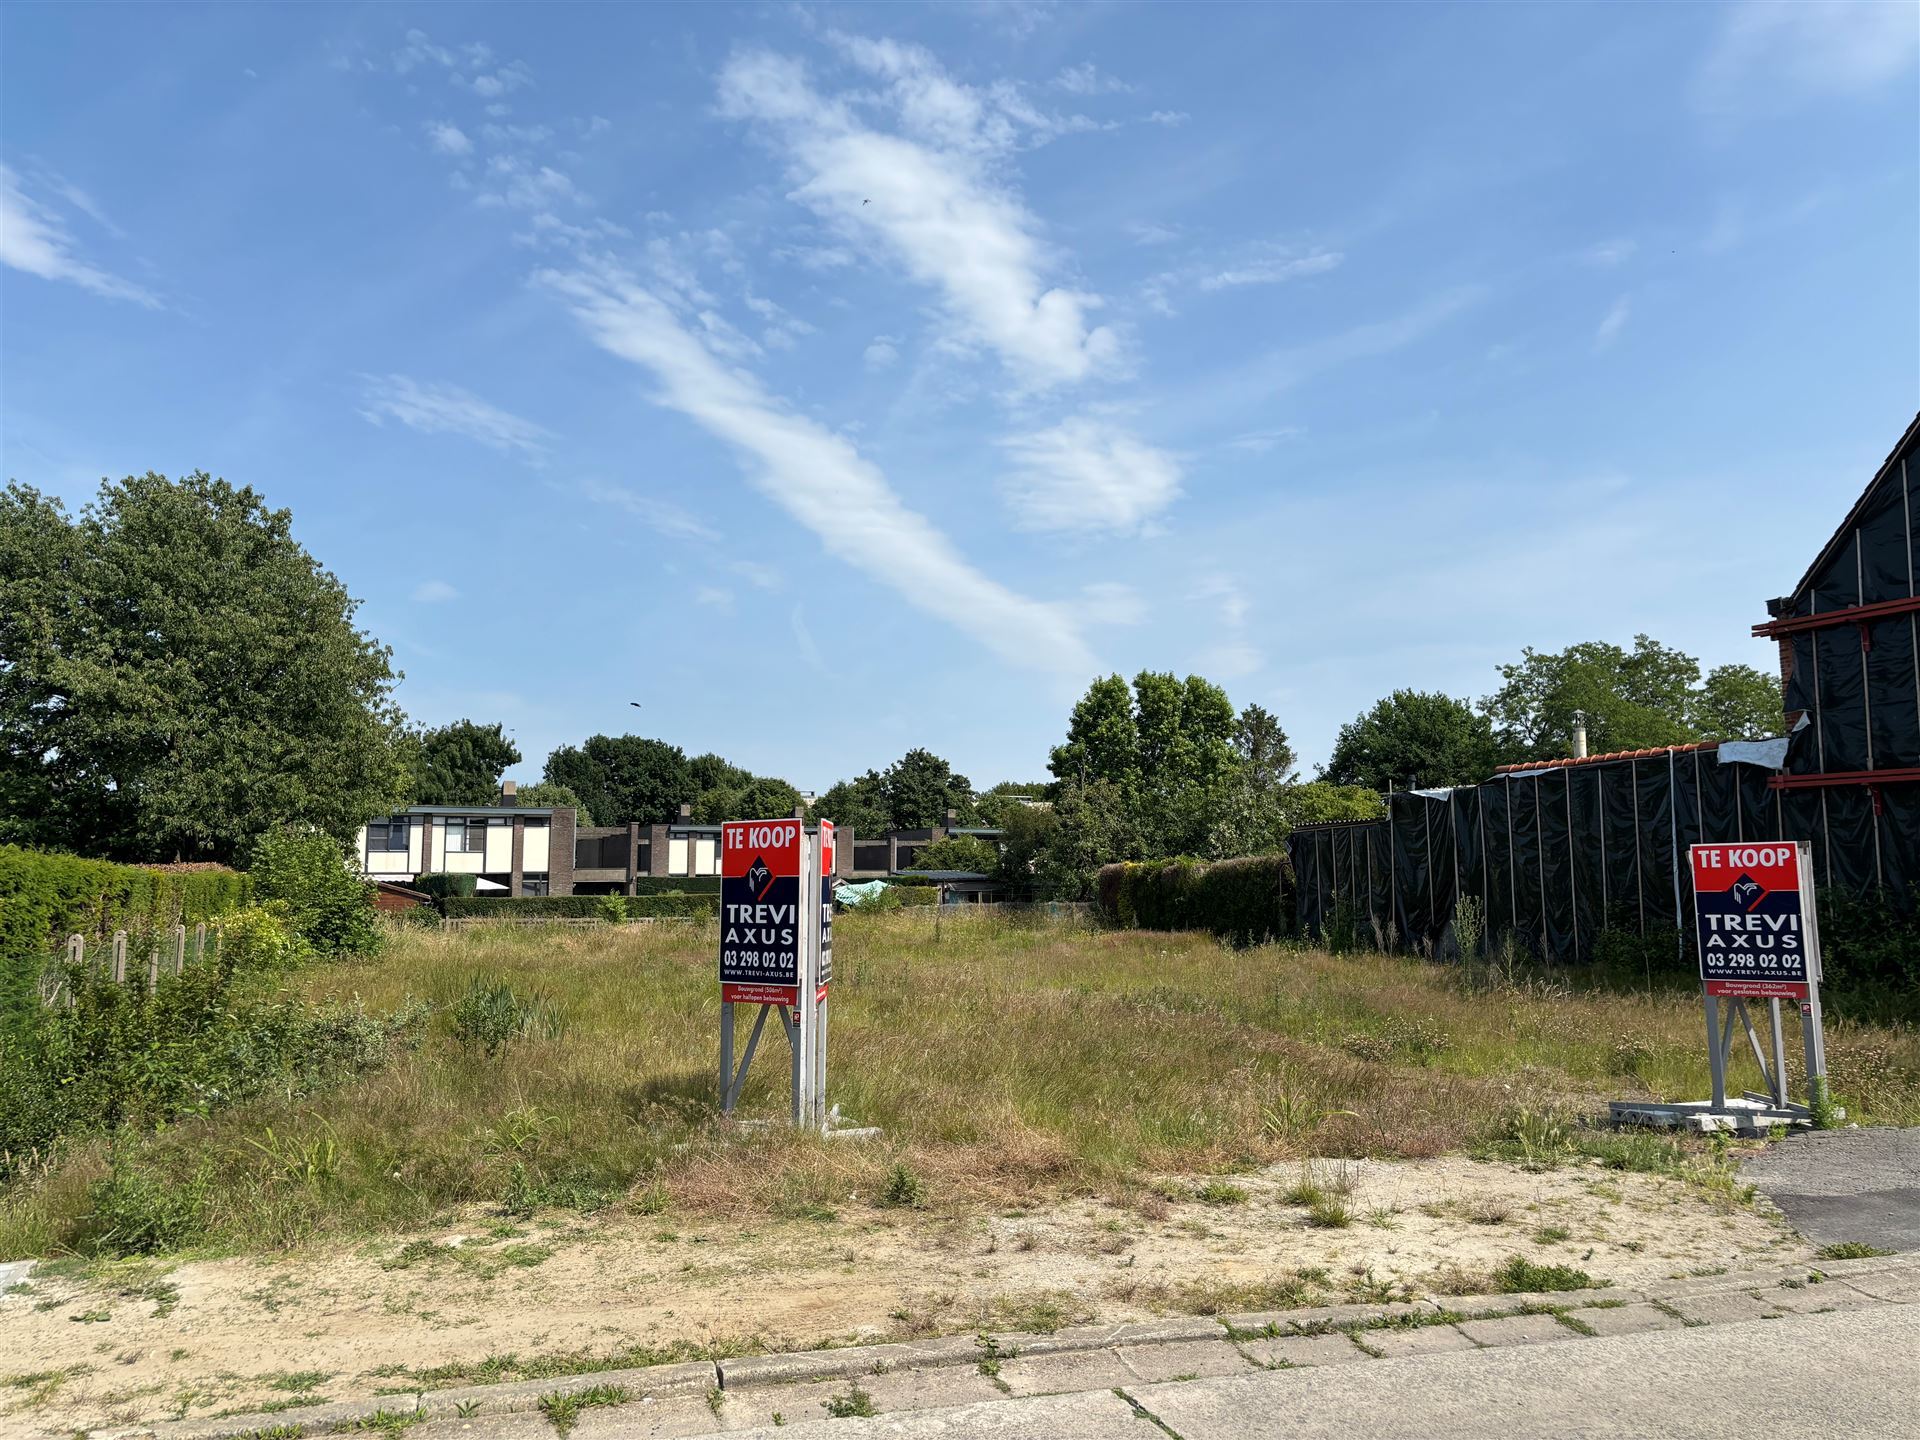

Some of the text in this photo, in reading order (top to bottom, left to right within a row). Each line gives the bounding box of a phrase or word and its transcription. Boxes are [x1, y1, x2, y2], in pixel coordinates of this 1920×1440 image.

[727, 826, 796, 849] TE KOOP
[1698, 848, 1790, 868] TE KOOP
[727, 904, 795, 924] TREVI
[1705, 914, 1798, 931] TREVI
[725, 928, 793, 945] AXUS
[1706, 934, 1797, 948] AXUS
[724, 950, 794, 968] 03 298 02 02
[1707, 953, 1801, 968] 03 298 02 02
[724, 969, 794, 978] WWW.TREVI-AXUS.BE
[738, 985, 764, 993] Bouwgrond
[763, 995, 789, 1003] bebouwing
